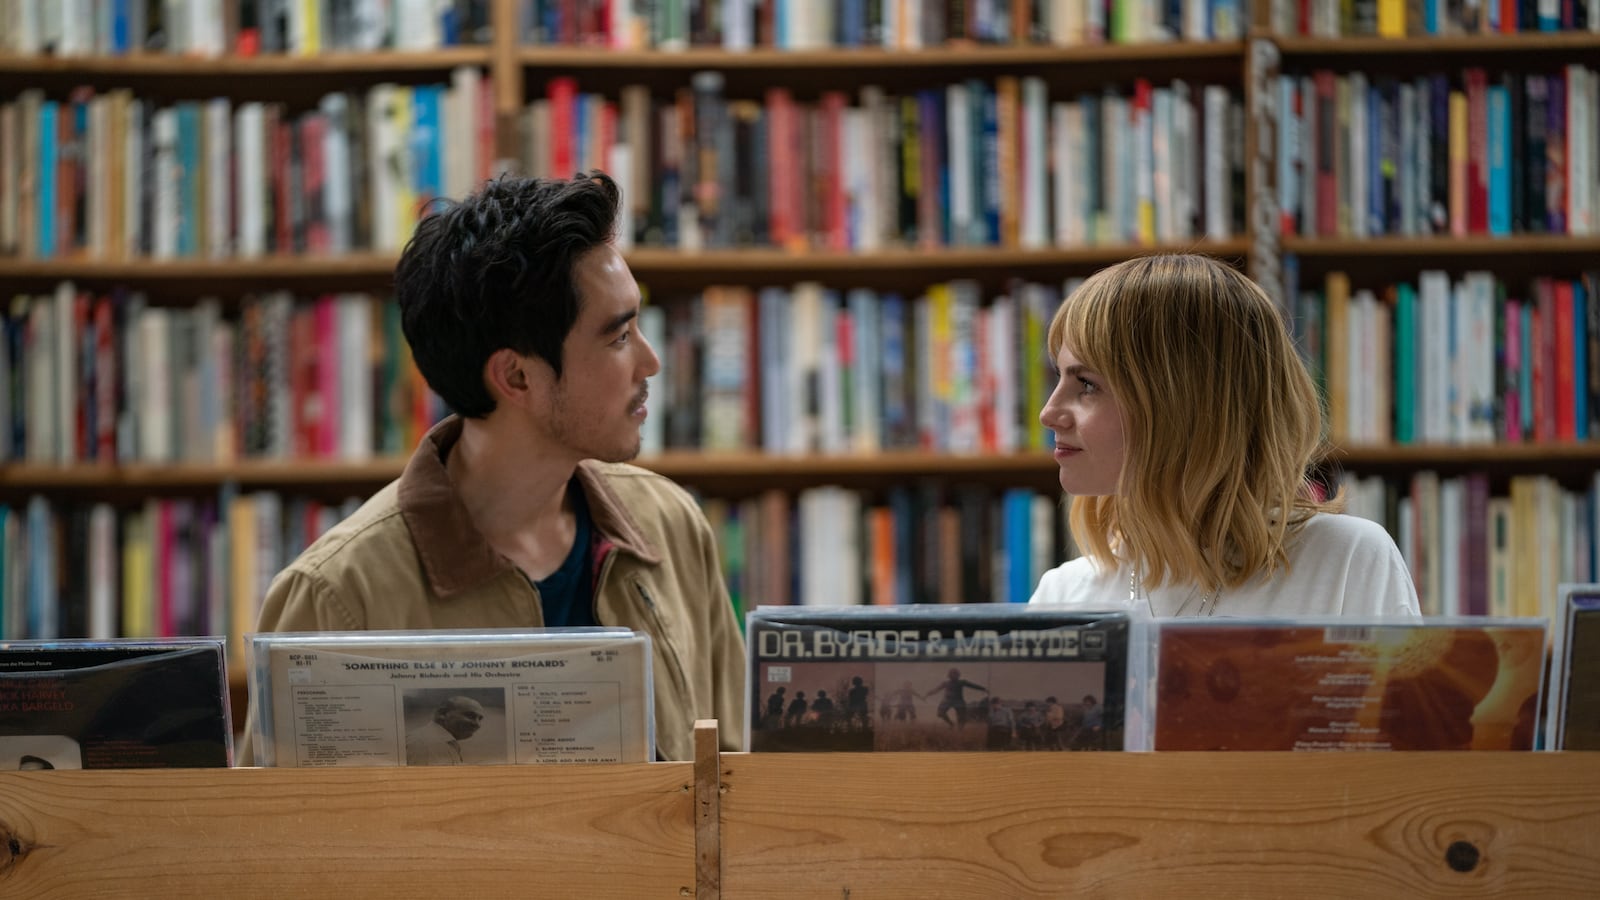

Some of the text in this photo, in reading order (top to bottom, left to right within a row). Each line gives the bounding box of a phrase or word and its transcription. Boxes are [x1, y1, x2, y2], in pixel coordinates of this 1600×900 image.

[926, 630, 947, 656] &
[461, 661, 506, 669] JOHNNY
[22, 690, 66, 700] HARVEY
